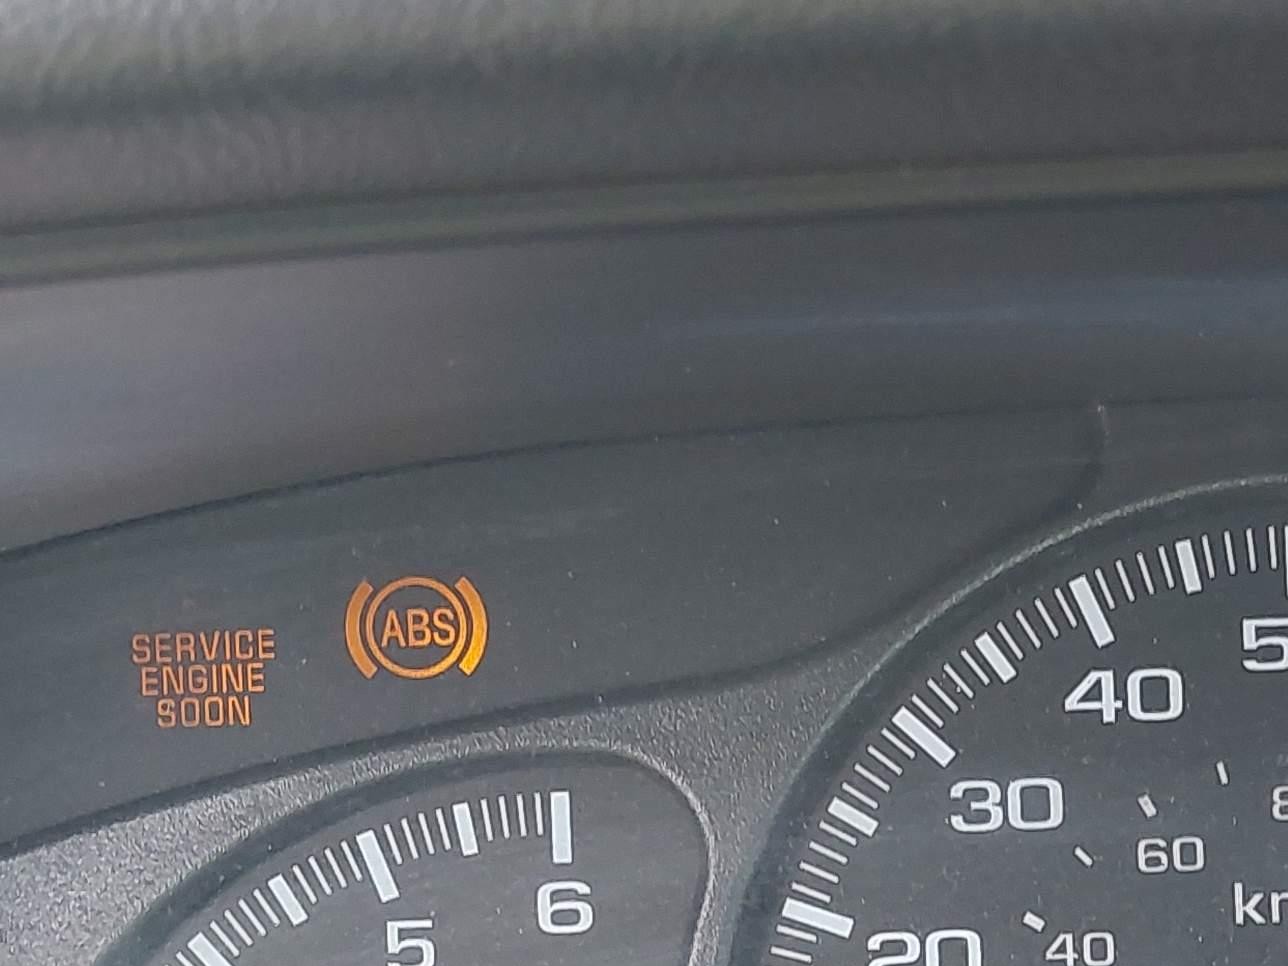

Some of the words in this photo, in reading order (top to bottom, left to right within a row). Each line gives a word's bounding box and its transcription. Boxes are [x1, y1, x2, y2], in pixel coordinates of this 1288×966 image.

[131, 628, 275, 665] SERVICE
[381, 605, 457, 650] ABS
[141, 662, 265, 697] ENGINE
[1064, 668, 1183, 724] 40
[156, 696, 252, 728] SOON
[950, 777, 1064, 832] 30
[1137, 836, 1205, 873] 60
[537, 881, 593, 934] 6
